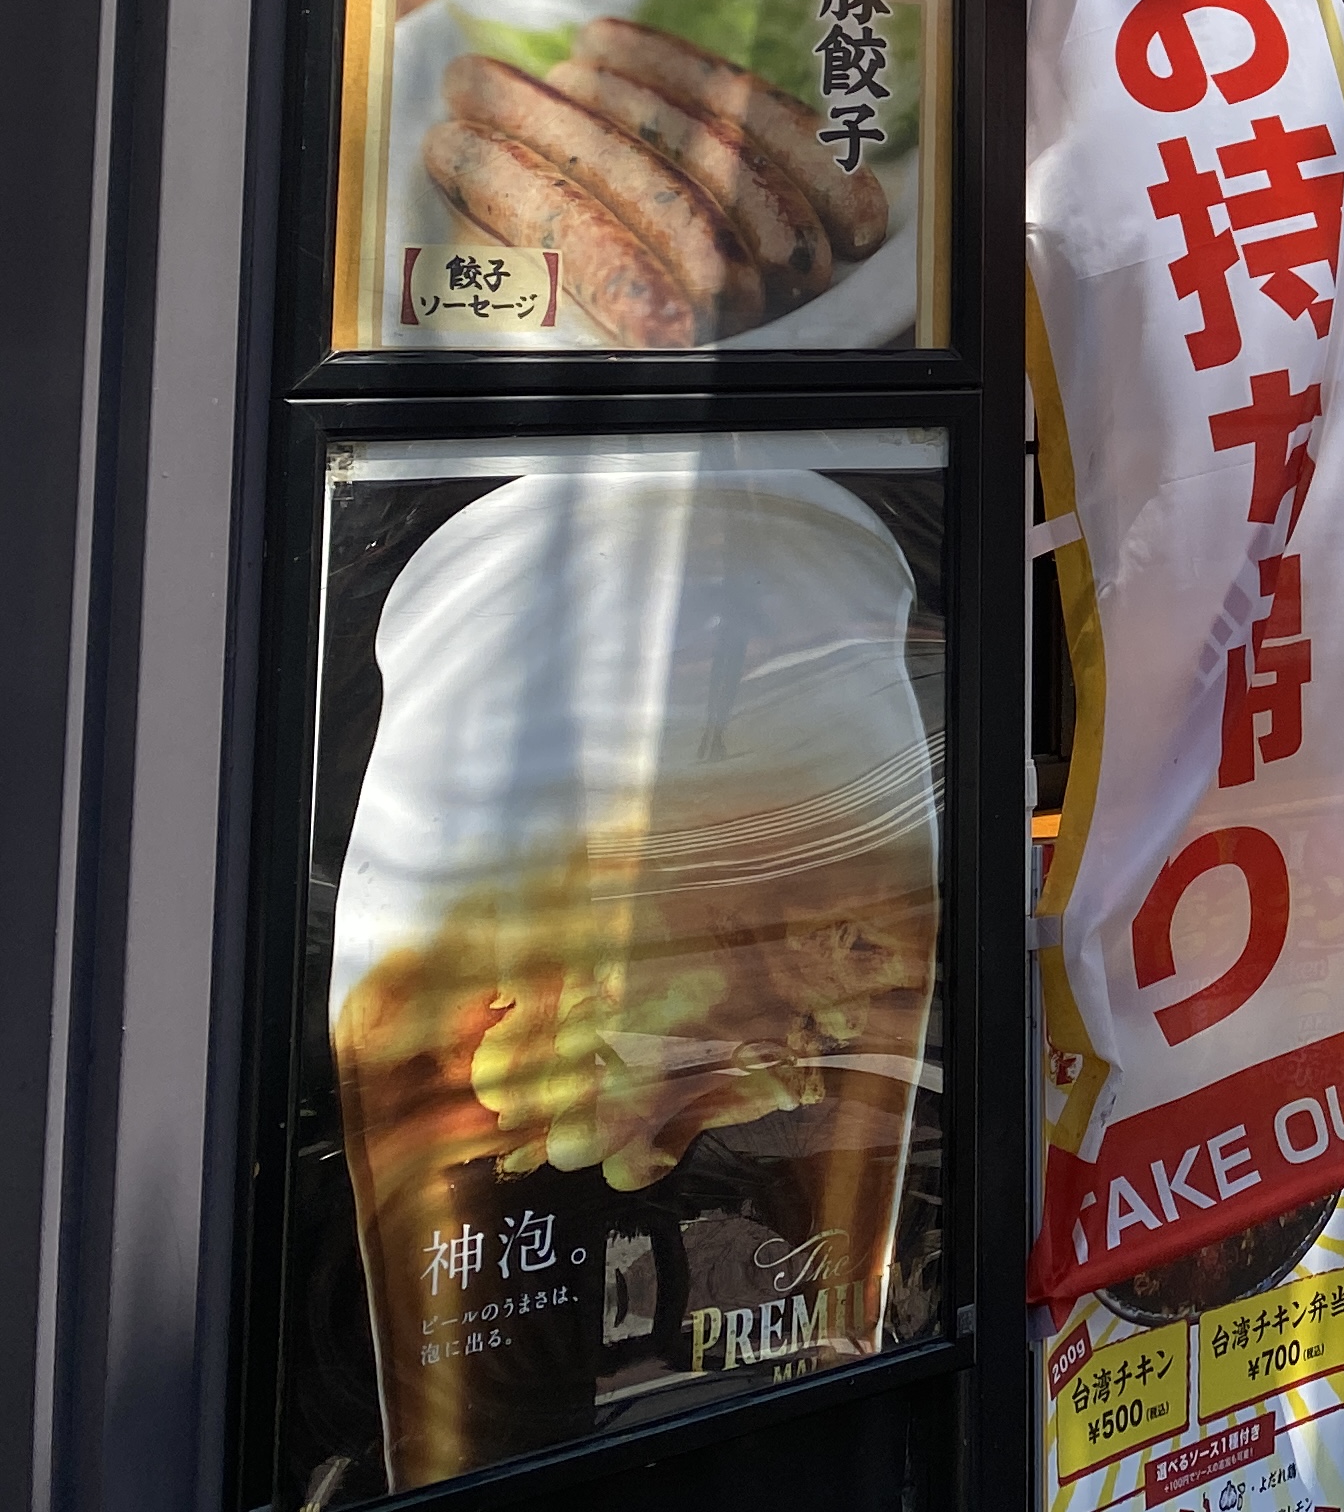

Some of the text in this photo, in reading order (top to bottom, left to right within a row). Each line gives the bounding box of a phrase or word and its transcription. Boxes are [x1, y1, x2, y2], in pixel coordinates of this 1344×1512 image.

[445, 255, 511, 291] 餃子
[420, 287, 539, 322] ソーセージ
[1071, 1122, 1263, 1266] TAKE
[420, 1208, 587, 1297] 神泡。
[754, 1228, 868, 1292] The
[421, 1285, 580, 1337] ビールのうまさは、
[420, 1329, 514, 1367] 泡に出る。
[1051, 1337, 1087, 1386] 200g
[1070, 1348, 1175, 1414] 台湾チキン
[1155, 1423, 1260, 1483] 選べるソース1種付き
